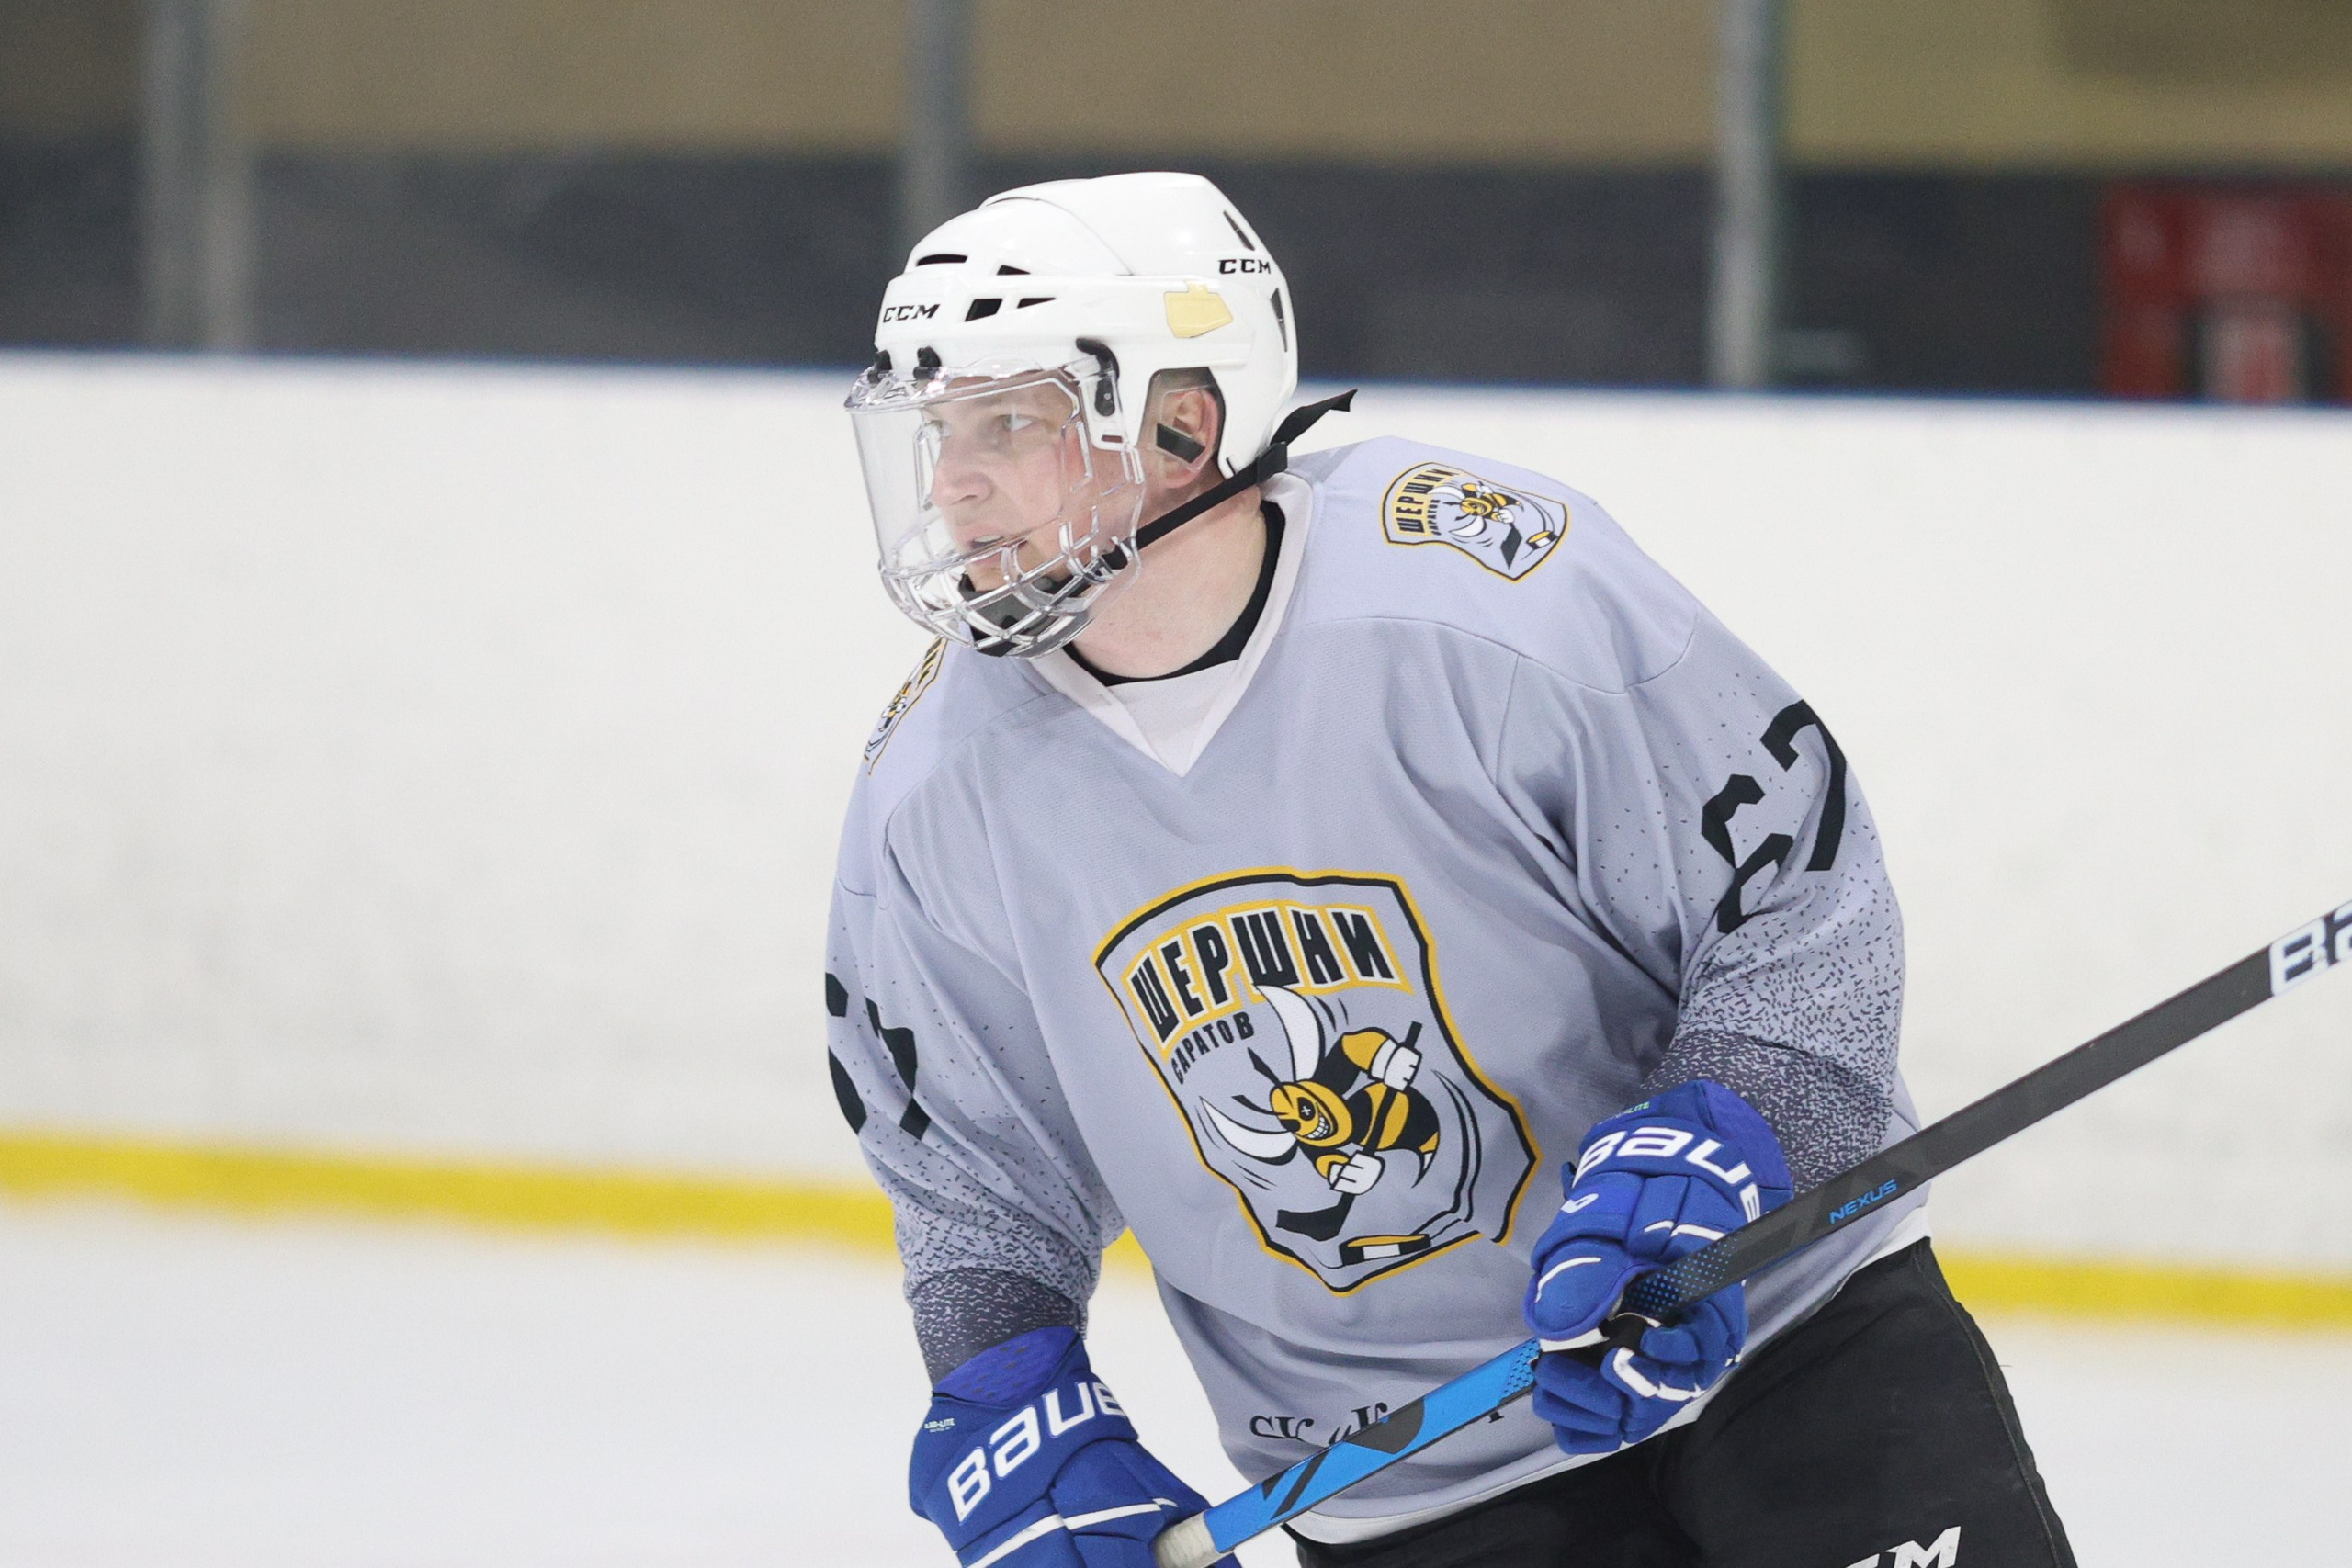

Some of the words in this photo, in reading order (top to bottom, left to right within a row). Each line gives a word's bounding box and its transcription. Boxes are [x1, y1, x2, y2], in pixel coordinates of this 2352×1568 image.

[1218, 258, 1272, 275] CCM
[882, 303, 941, 322] CCM
[1395, 468, 1460, 534] ШЕРШНИ
[1129, 908, 1397, 1044] ШЕРШНИ
[1170, 1011, 1255, 1086] САРАТОВ
[1571, 1126, 1764, 1224] BAUE
[1828, 1179, 1898, 1224] NEXUS
